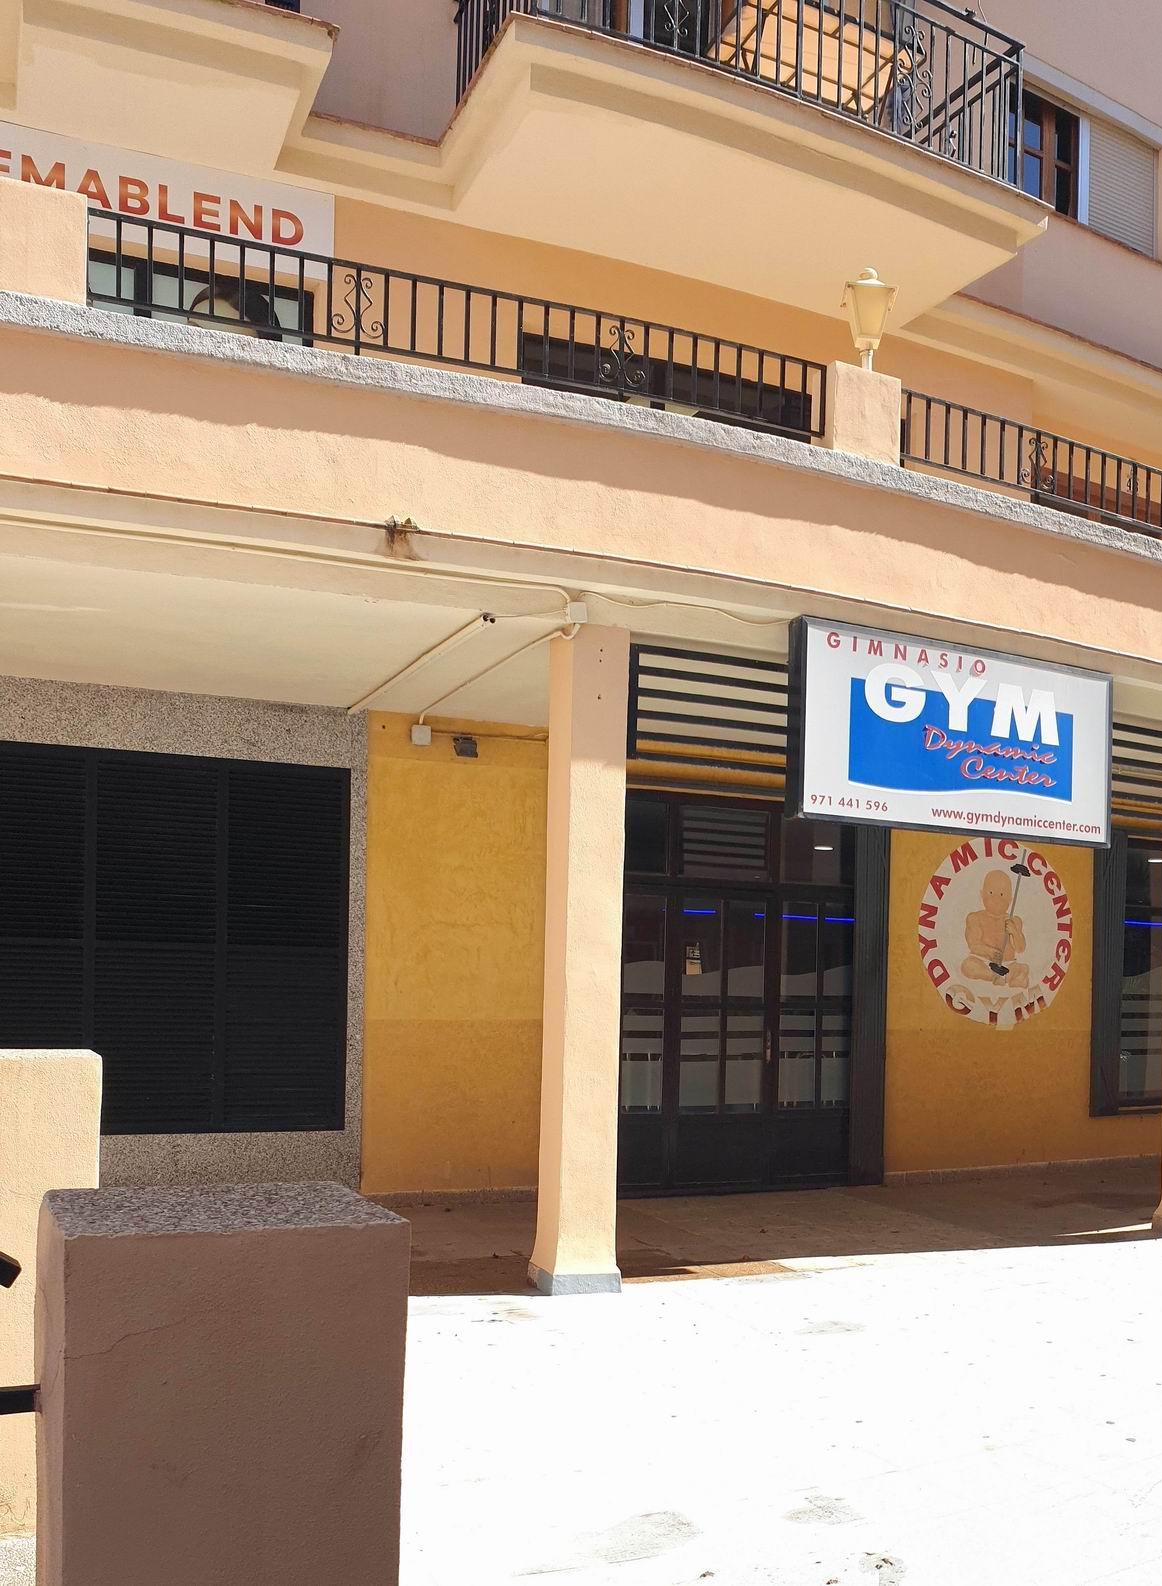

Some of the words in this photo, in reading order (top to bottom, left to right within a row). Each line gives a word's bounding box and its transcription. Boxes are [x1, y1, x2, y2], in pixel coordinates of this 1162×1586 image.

[826, 631, 987, 677] GIMNASIO
[864, 662, 1060, 746] GYM
[922, 723, 1058, 766] Dynamic
[959, 755, 1057, 788] Center
[810, 793, 833, 807] 971
[838, 796, 861, 810] 441
[865, 799, 889, 813] 596
[931, 806, 1101, 835] www.gymdynamiccenter.com
[918, 837, 1020, 988] DYNAMIC
